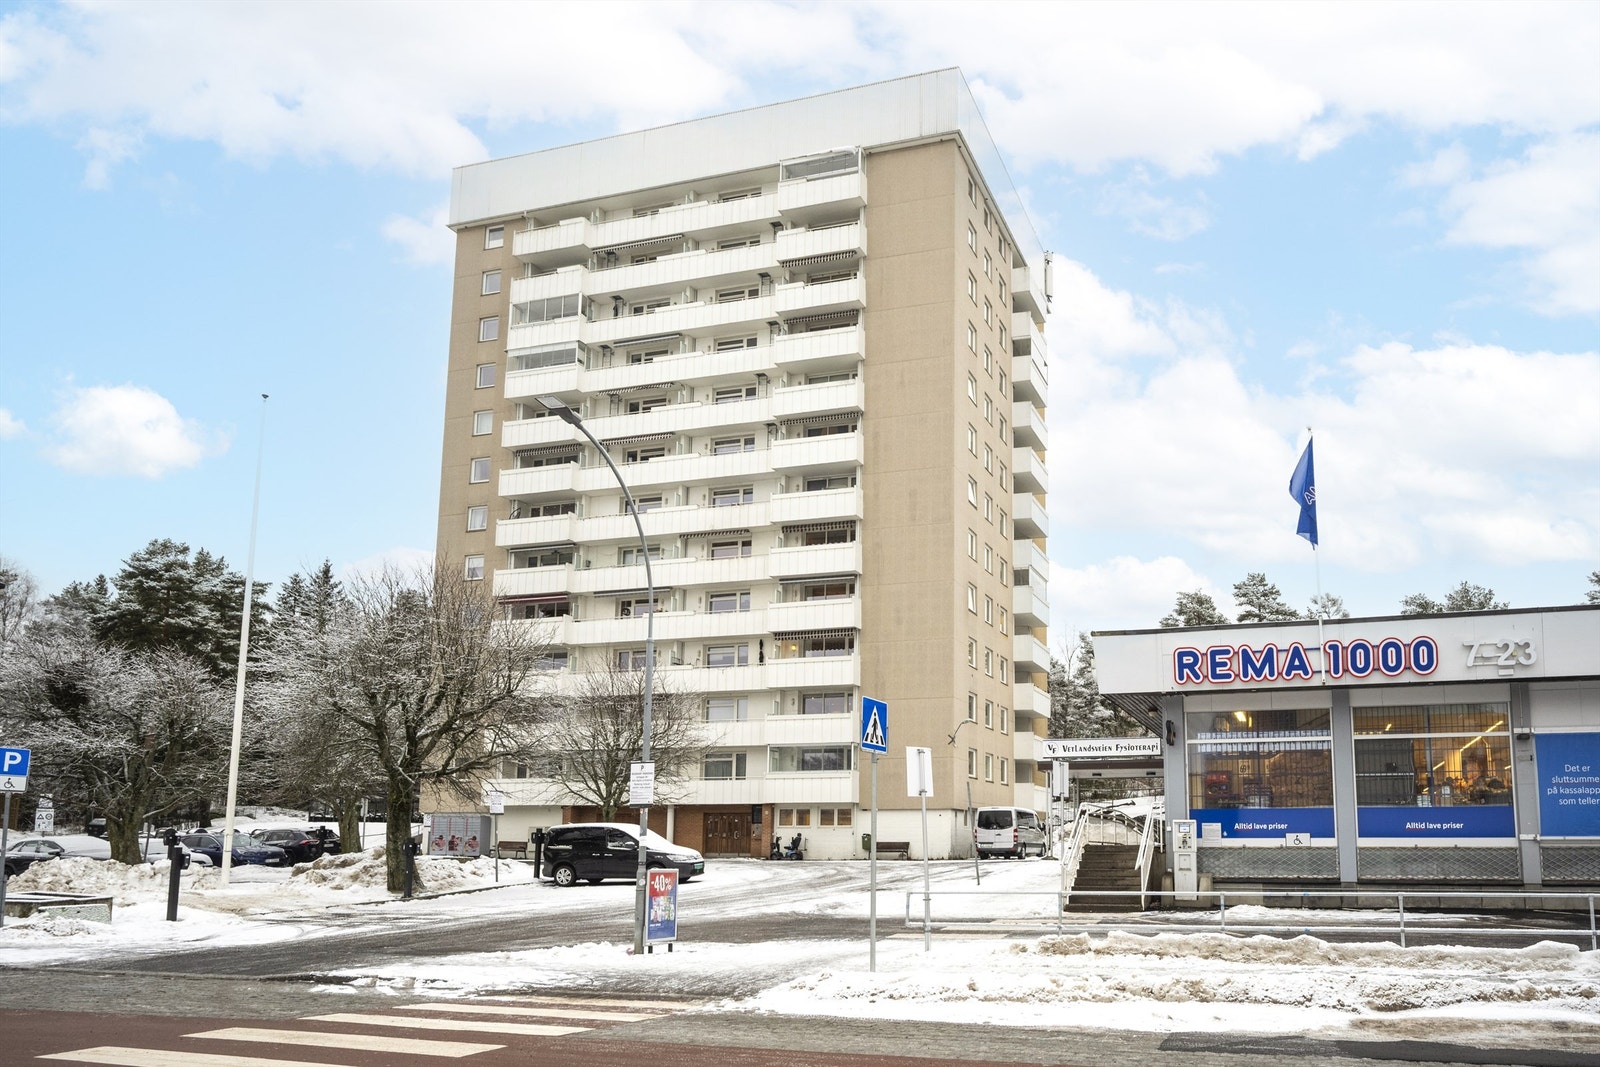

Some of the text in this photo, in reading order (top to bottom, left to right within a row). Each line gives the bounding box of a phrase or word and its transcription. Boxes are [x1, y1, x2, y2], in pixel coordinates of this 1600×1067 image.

[1174, 636, 1438, 684] REMA 1000
[3, 751, 22, 772] P
[1564, 764, 1580, 772] Det
[1548, 786, 1557, 795] på
[1578, 796, 1600, 805] teller
[1234, 822, 1288, 831] Alltid lave priser
[1442, 822, 1464, 830] priser
[651, 874, 672, 892] -40%
